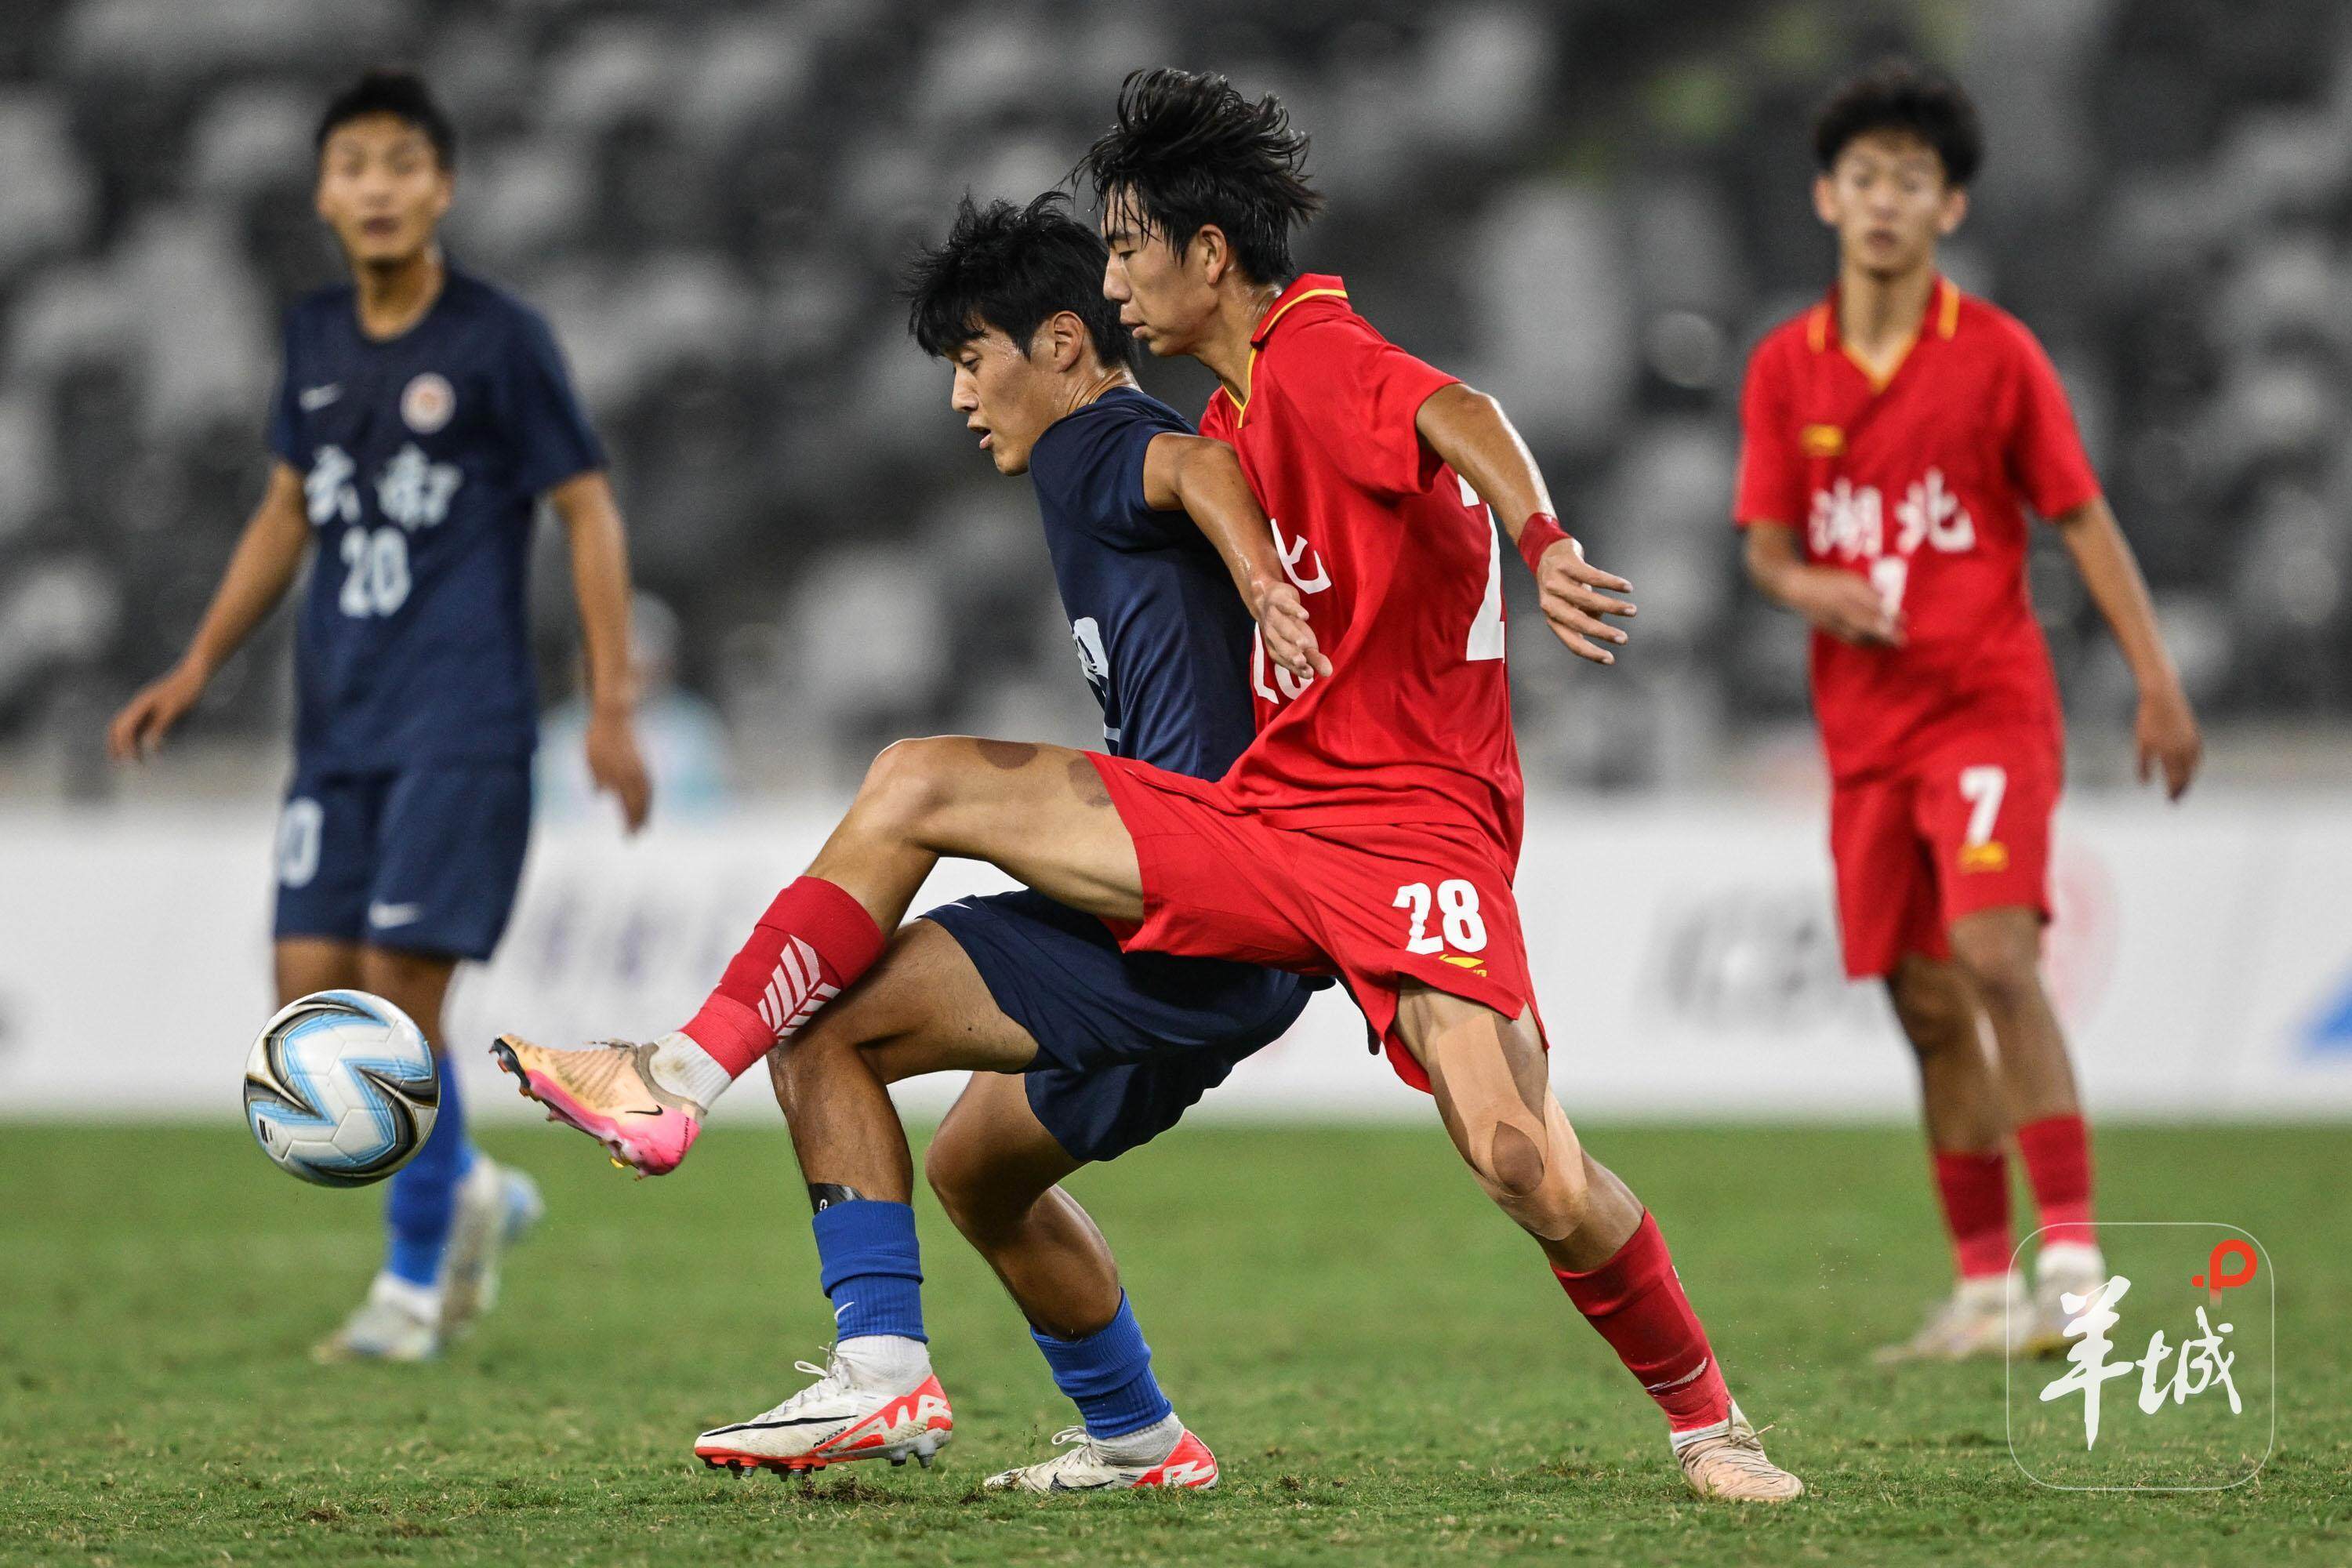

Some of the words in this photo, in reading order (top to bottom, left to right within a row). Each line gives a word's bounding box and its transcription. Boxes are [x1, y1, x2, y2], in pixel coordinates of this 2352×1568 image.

[1808, 467, 1976, 561] 湖北
[339, 525, 412, 618] 20
[1958, 764, 2008, 848] 7
[1392, 879, 1488, 955] 28
